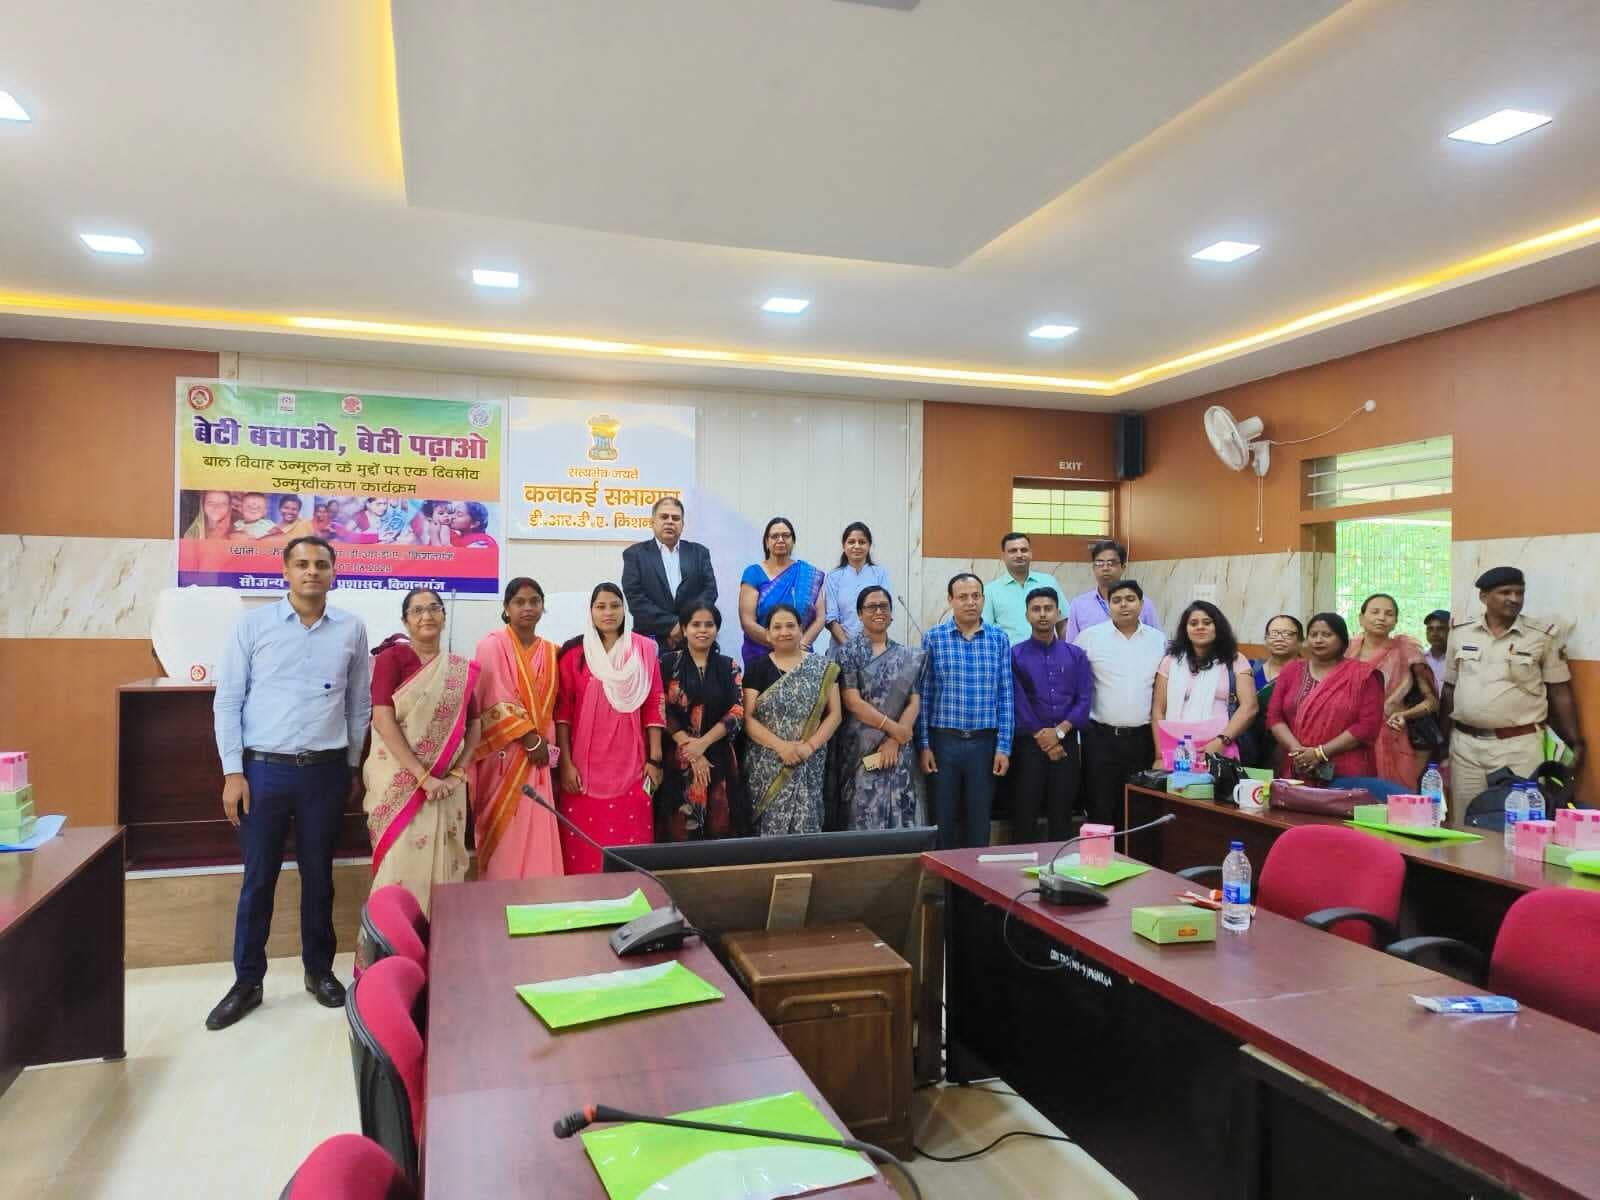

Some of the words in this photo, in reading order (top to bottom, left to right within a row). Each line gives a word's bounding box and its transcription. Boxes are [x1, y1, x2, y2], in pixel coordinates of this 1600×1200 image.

[194, 416, 241, 445] बेटी
[248, 424, 346, 456] बचाओ,
[357, 426, 402, 455] बेटी
[408, 433, 488, 462] पढ़ाओ
[202, 456, 232, 468] बाल
[235, 455, 275, 470] विवाह
[279, 460, 331, 475] उन्मूलन
[336, 461, 352, 473] के
[357, 462, 380, 478] मुद्दों
[383, 466, 400, 476] पर
[404, 466, 428, 477] एक
[432, 465, 480, 480] दिवसीय
[1059, 461, 1083, 471] EXIT
[272, 476, 356, 491] उन्मुखीकरण
[360, 480, 416, 494] कार्यक्रम
[524, 480, 599, 507] कनकई
